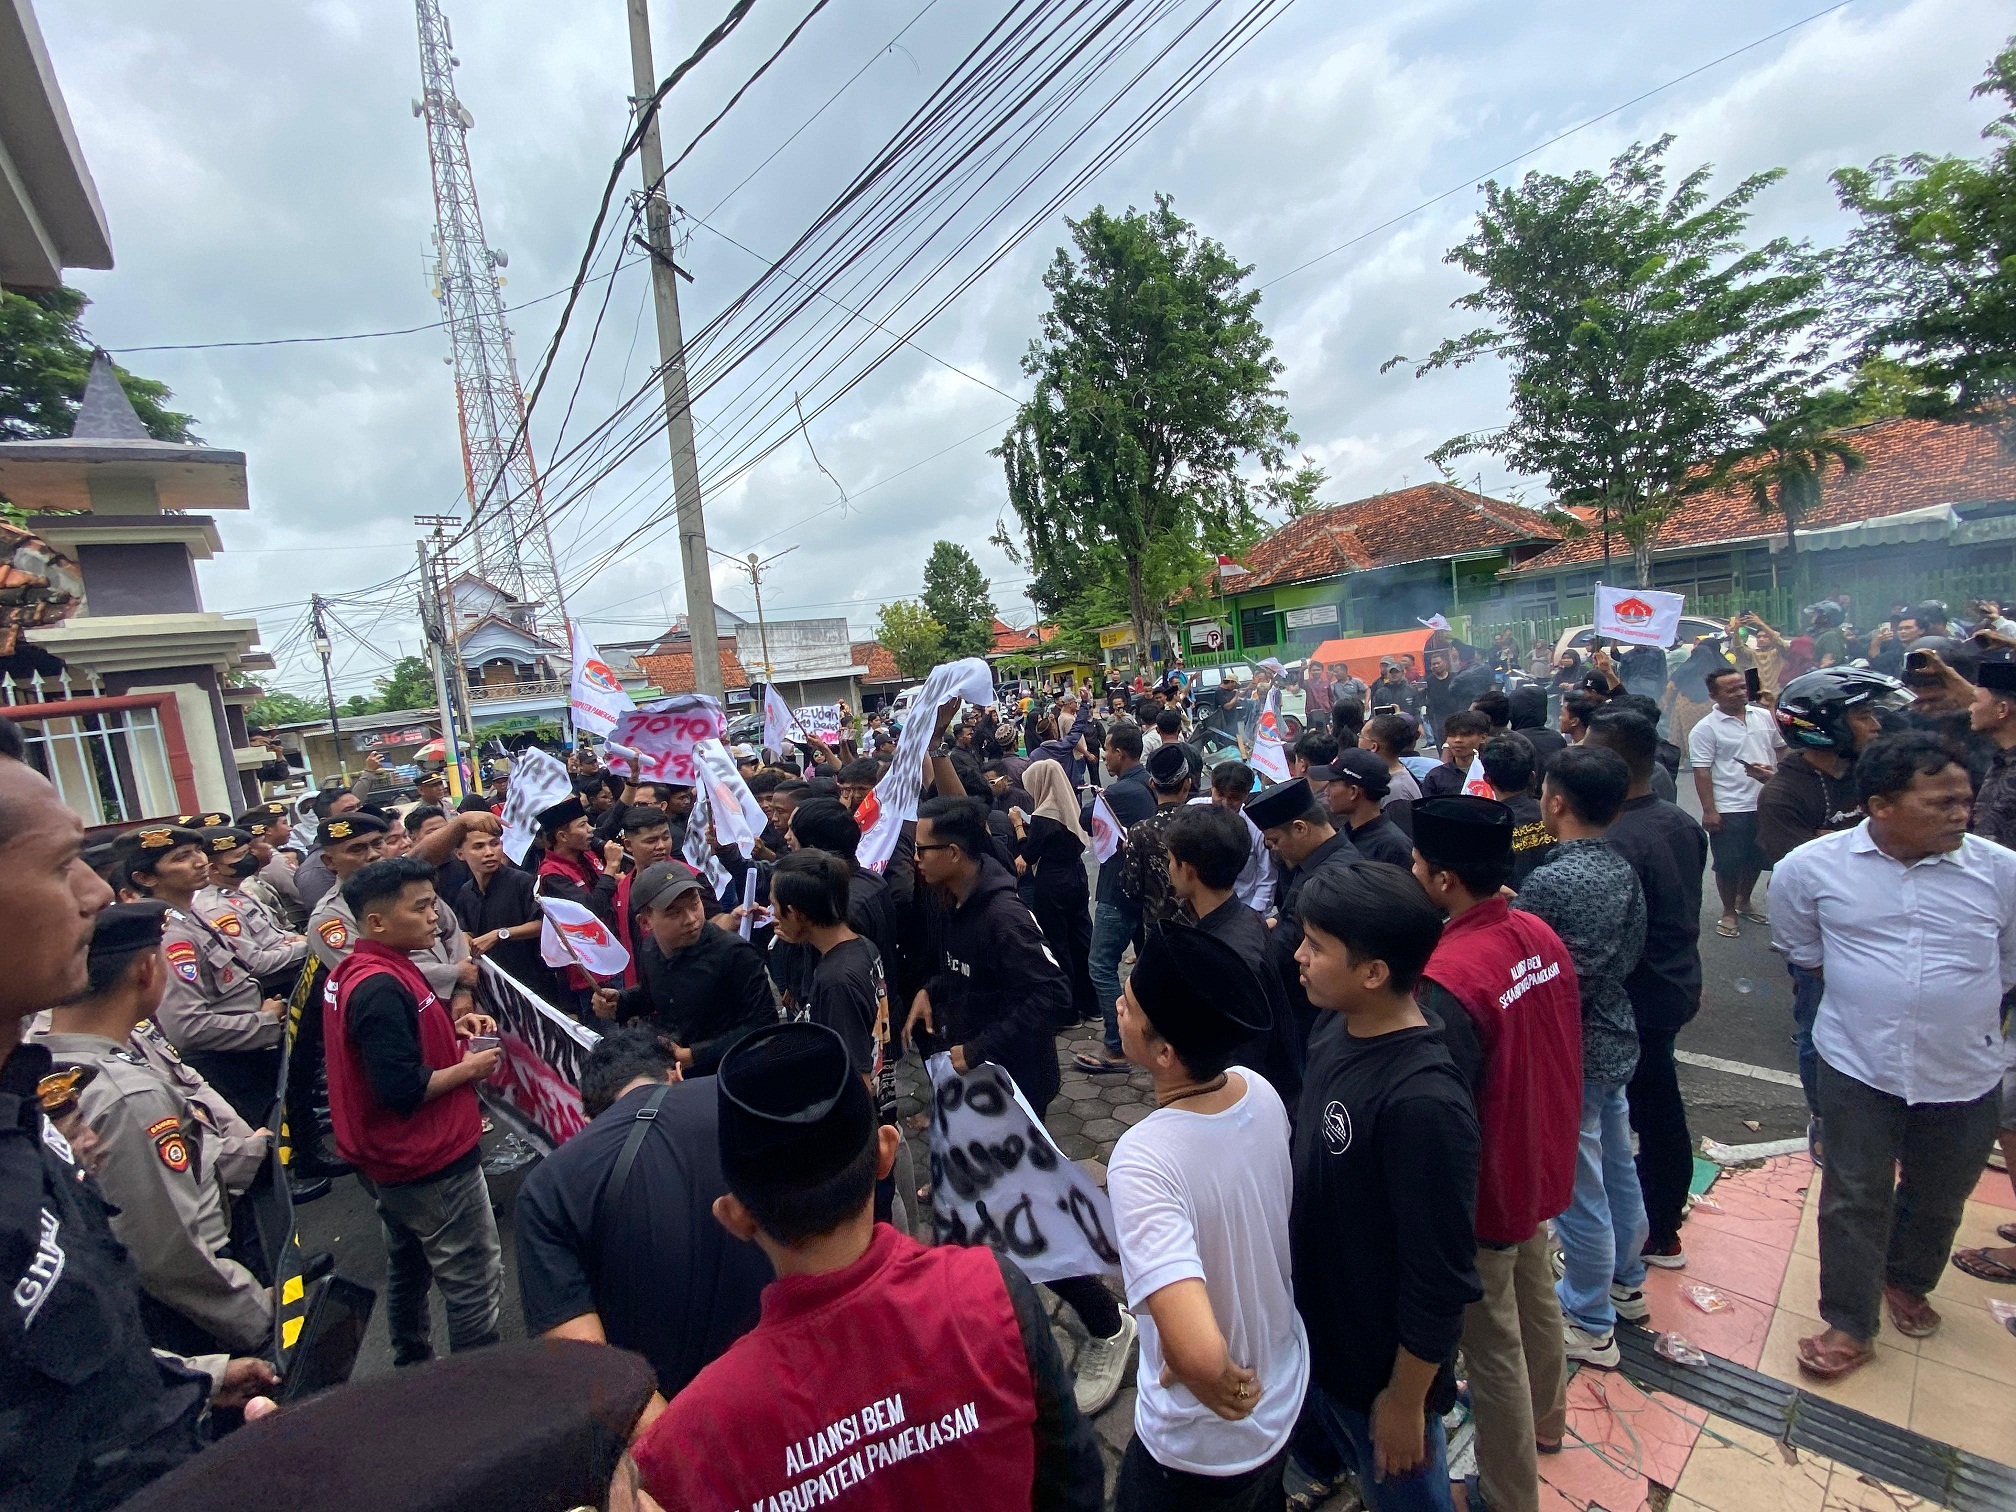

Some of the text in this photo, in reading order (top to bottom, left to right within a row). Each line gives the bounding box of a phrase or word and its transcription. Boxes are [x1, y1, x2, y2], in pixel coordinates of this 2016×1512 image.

[592, 707, 617, 724] PAMEKASA
[785, 1393, 906, 1477] ALIANSI BEM
[864, 1401, 980, 1473] PAMEKASAN
